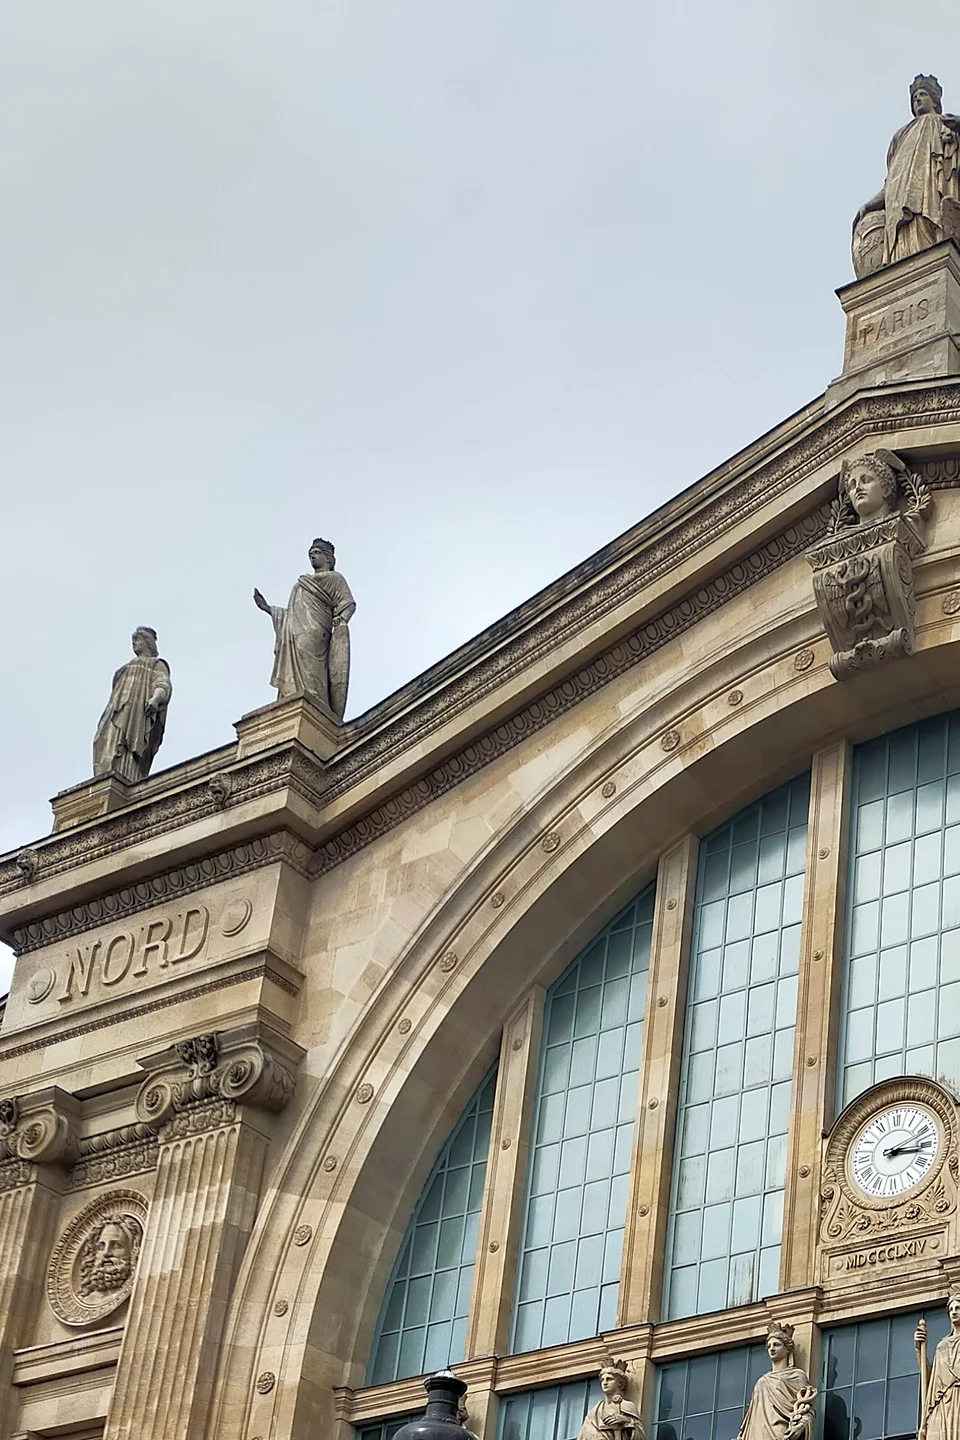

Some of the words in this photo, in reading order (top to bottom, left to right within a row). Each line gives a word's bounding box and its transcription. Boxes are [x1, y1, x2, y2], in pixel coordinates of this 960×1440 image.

[857, 298, 930, 347] PARIS
[56, 904, 211, 1004] NORD
[845, 1239, 927, 1270] MDCCCLXIV
